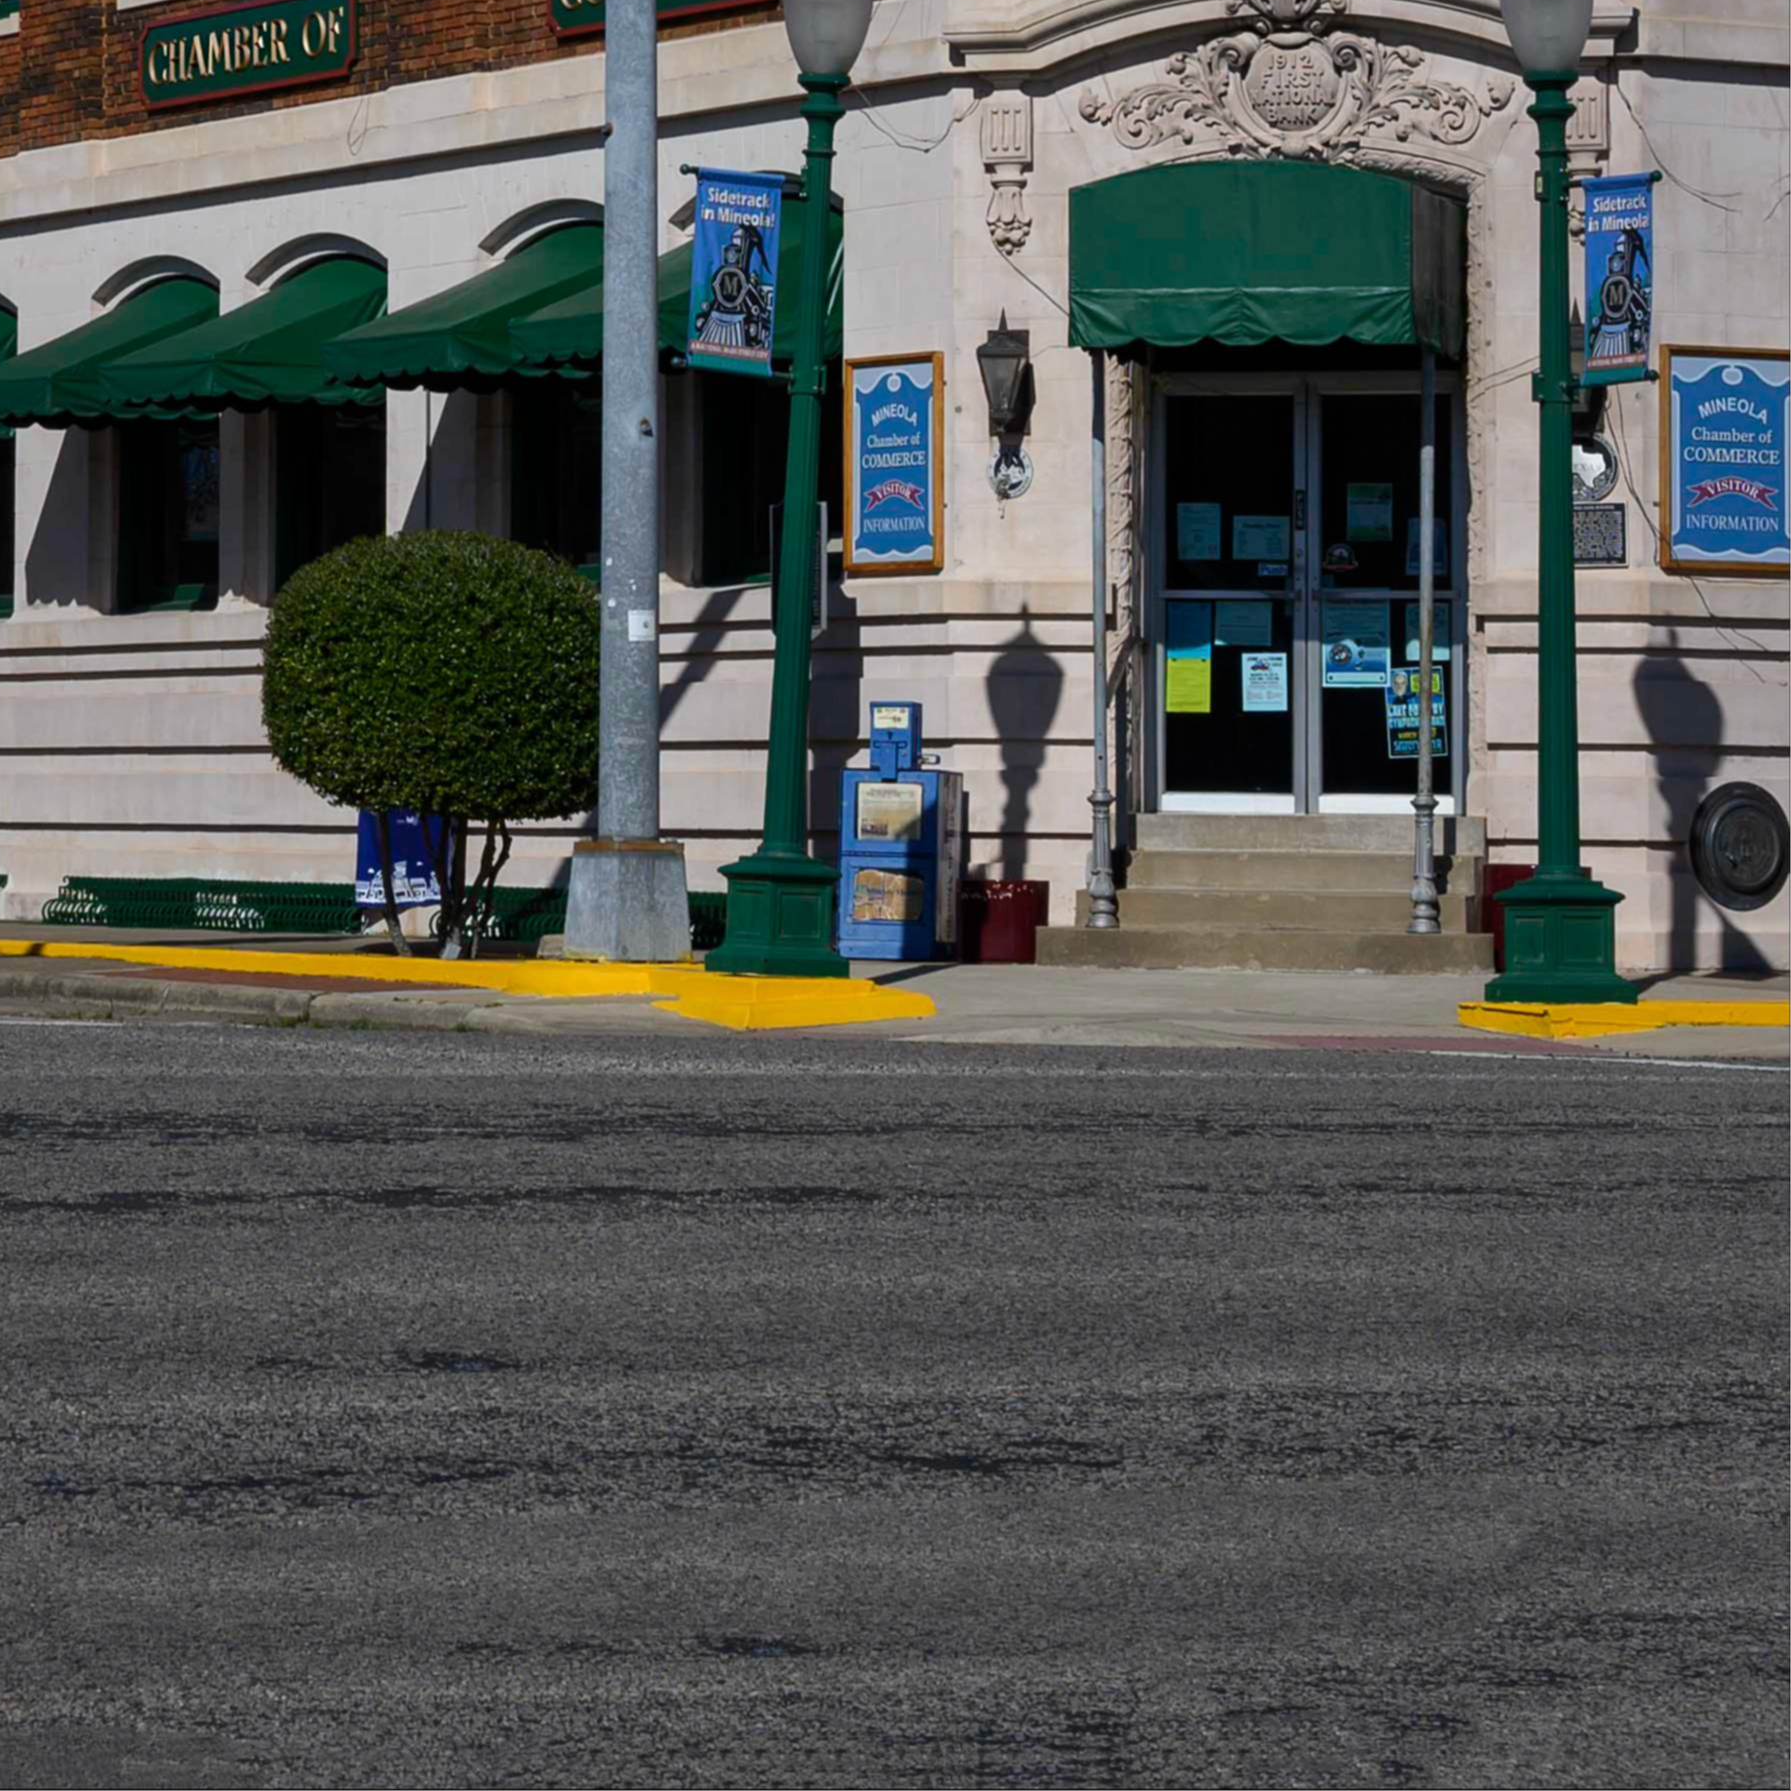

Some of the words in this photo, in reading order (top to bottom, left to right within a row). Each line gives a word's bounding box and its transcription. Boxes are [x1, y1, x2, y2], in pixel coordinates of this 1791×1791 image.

[148, 18, 291, 86] CHAMBER
[301, 6, 345, 58] OF
[1268, 54, 1314, 70] 1912
[1262, 70, 1325, 89] FIRST
[1252, 90, 1336, 108] NATIONAL
[1268, 108, 1319, 128] BANK
[708, 187, 769, 209] Sidetrack
[1593, 195, 1647, 213] Sidetrack
[701, 205, 715, 221] in
[717, 209, 775, 228] Mineola!
[1588, 217, 1601, 232] in
[871, 404, 919, 427] MINEOLA
[1697, 397, 1768, 425] MINEOLA
[867, 433, 908, 448] Chamber
[910, 431, 921, 445] of
[1691, 426, 1755, 443] Chamber
[1758, 430, 1773, 444] of
[862, 450, 926, 469] COMMERCE
[1683, 446, 1781, 465] COMMERCE
[876, 482, 912, 500] VISITOR
[1706, 479, 1759, 499] VISITOR
[863, 516, 925, 533] INFORMATION
[1686, 513, 1778, 532] INFORMATION
